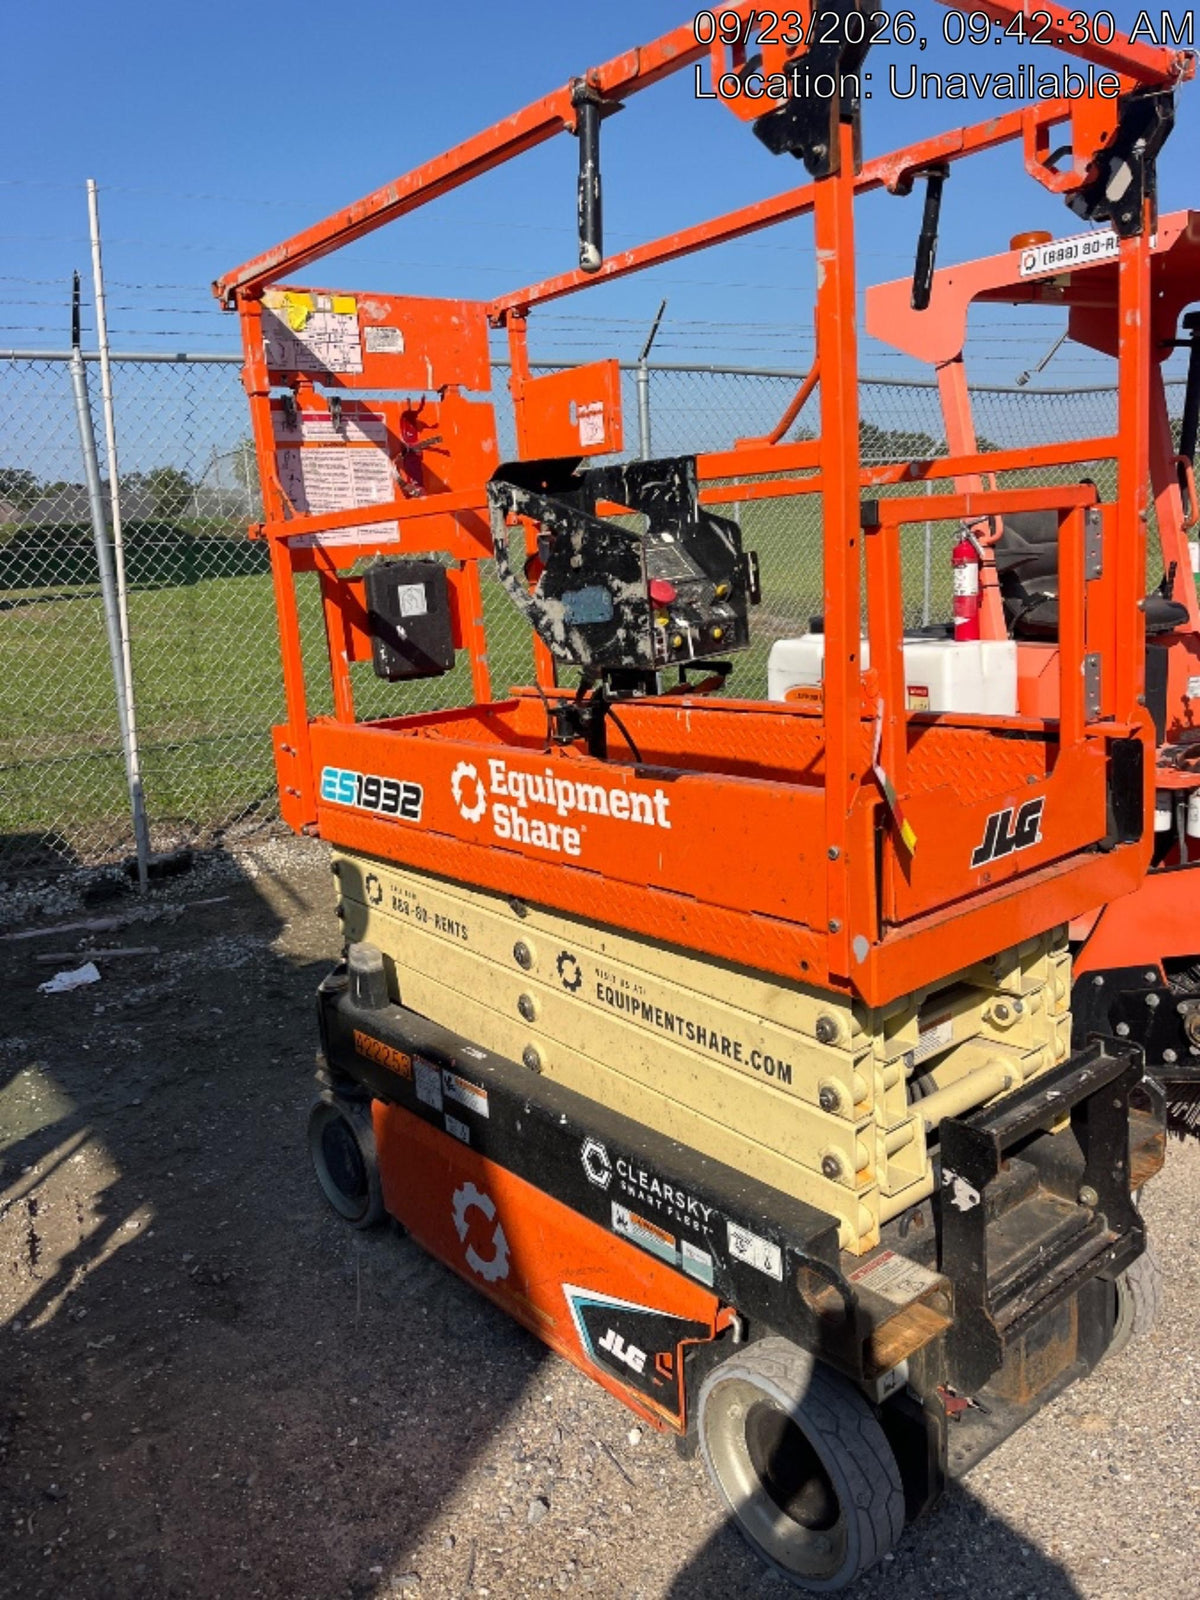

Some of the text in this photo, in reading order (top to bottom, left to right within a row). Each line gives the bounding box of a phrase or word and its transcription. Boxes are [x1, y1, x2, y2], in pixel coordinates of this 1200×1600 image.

[1043, 244, 1079, 266] (888)
[322, 767, 422, 821] ES1932
[488, 758, 672, 829] Equipment
[491, 802, 582, 856] Share
[970, 796, 1045, 868] JLG
[596, 982, 793, 1085] EQUIPMENTSHARE.COM
[616, 1160, 713, 1222] CLEARSKY
[620, 1180, 663, 1209] SMART
[598, 1328, 648, 1373] JLG
